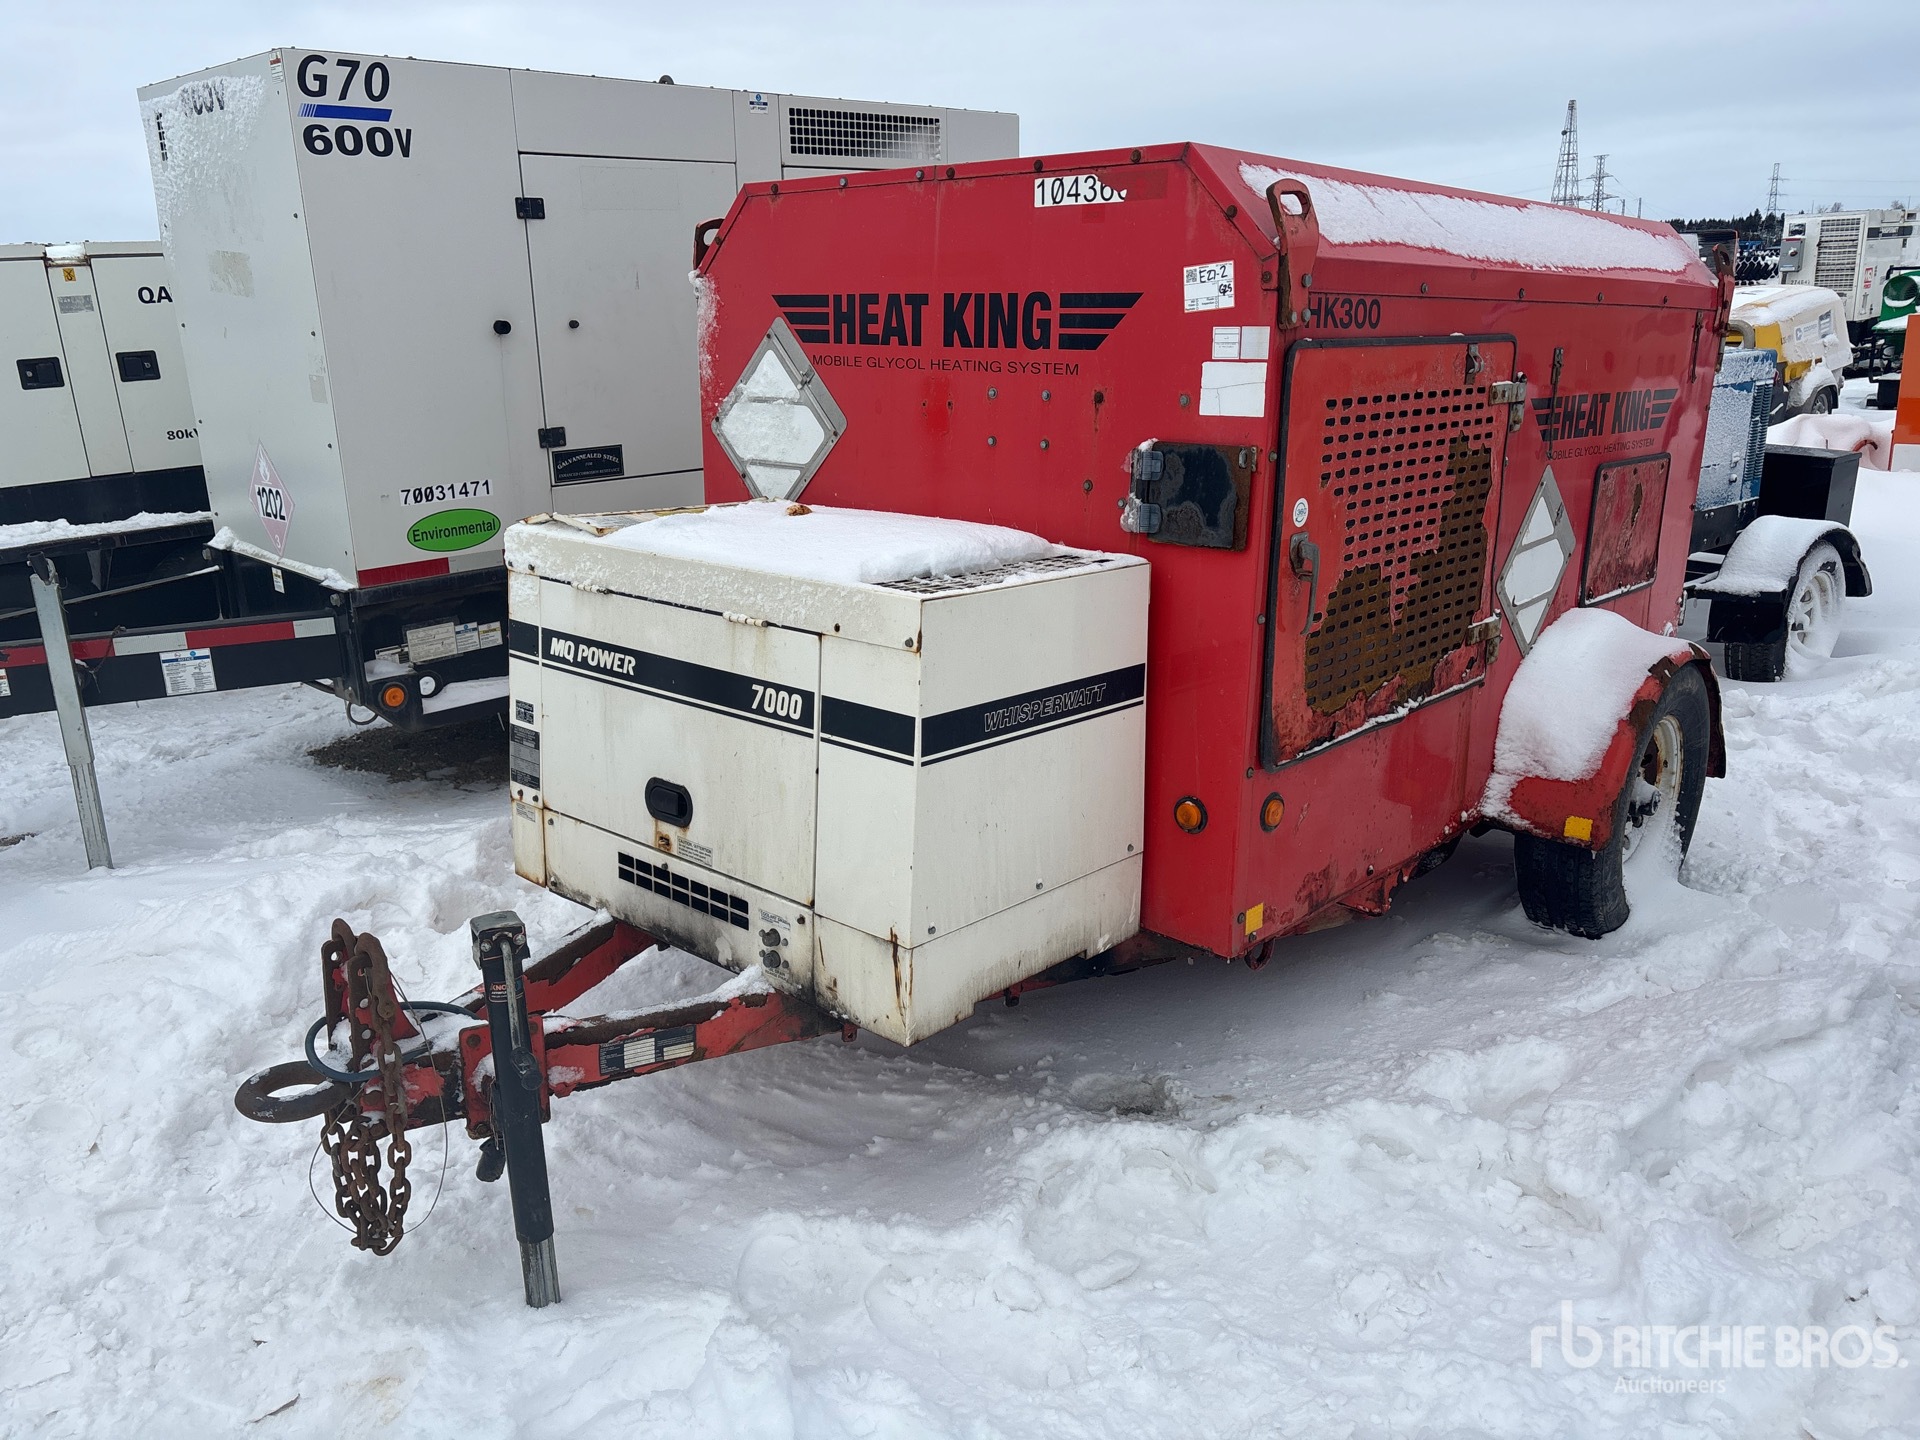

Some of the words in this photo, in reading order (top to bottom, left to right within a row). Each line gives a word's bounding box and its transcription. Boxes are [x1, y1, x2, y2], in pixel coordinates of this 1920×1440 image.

[296, 54, 390, 102] G70
[302, 124, 412, 158] 600V
[833, 293, 929, 346] HEAT
[943, 291, 1052, 350] KING
[1304, 297, 1381, 329] HK300
[811, 354, 862, 368] MOBILE
[866, 356, 925, 370] GLYCOL
[930, 358, 1002, 373] HEATING
[1007, 360, 1080, 376] SYSTEM
[1560, 393, 1611, 440] HEAT
[1611, 388, 1652, 434] KING
[603, 454, 620, 463] STEEL
[1549, 449, 1573, 461] OBILE
[1574, 446, 1601, 458] GLYCOL
[1603, 440, 1631, 454] HEATING
[1631, 437, 1655, 449] SYSTEM
[256, 487, 286, 521] 1202
[401, 479, 491, 505] 70031471
[274, 534, 281, 548] 3
[412, 518, 497, 543] Environmental
[549, 637, 575, 663] MQ
[577, 643, 636, 676] POWER
[751, 684, 803, 720] 7000
[984, 683, 1107, 732] WHISPERWATT
